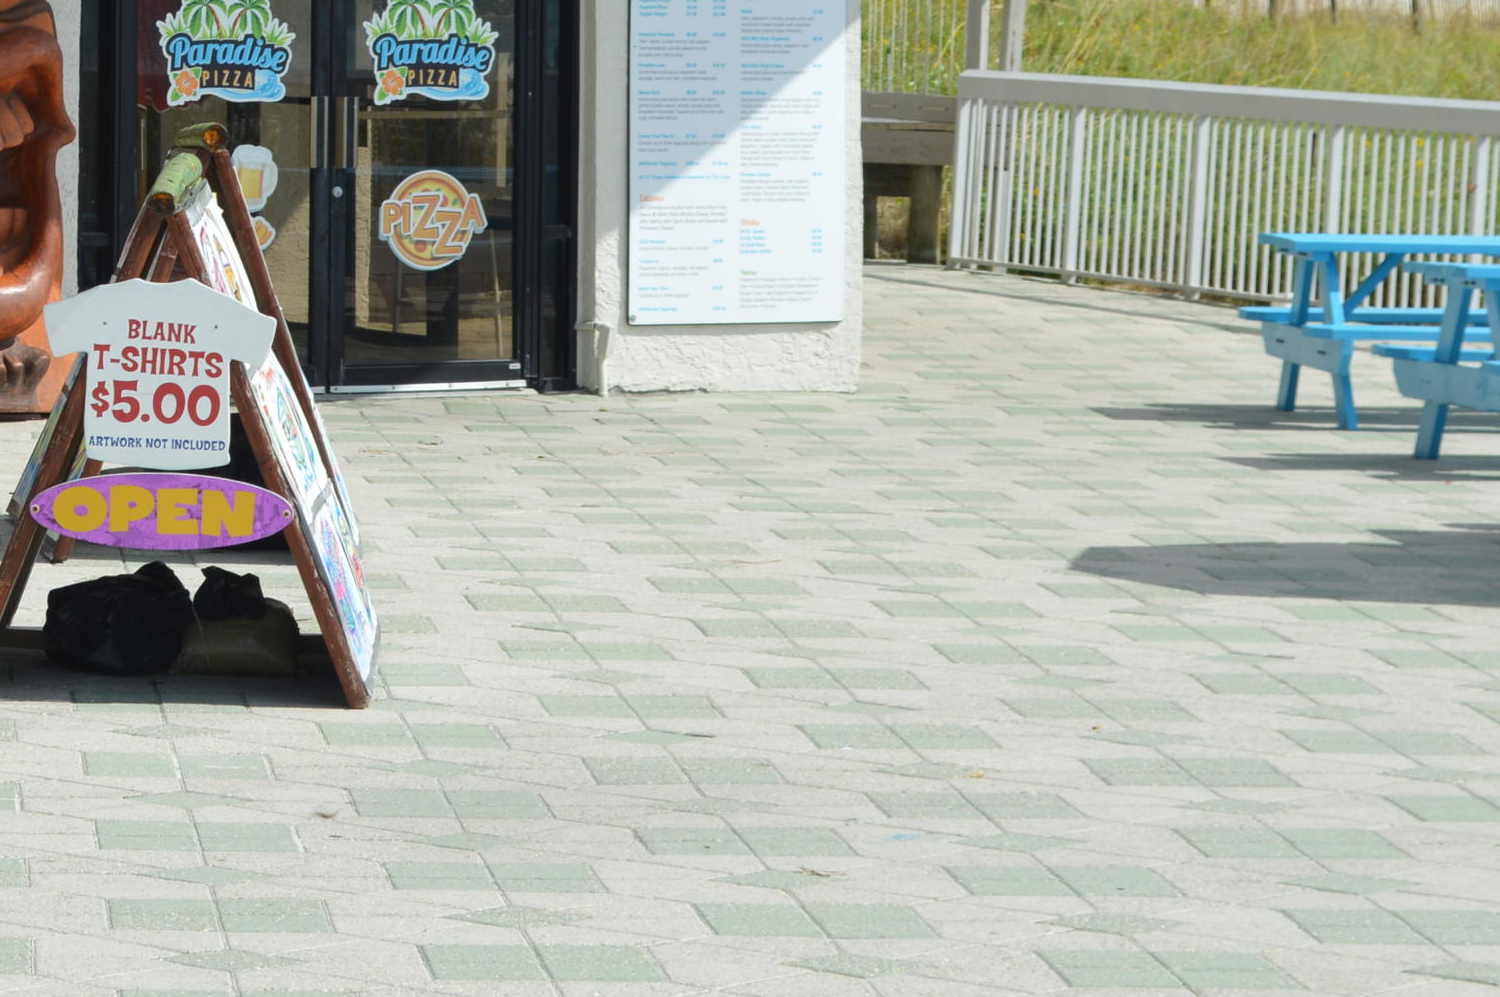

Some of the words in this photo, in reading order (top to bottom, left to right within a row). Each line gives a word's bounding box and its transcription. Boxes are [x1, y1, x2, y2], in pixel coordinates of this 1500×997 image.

[168, 36, 288, 72] Paradise
[375, 36, 492, 72] Paradise
[201, 69, 254, 88] PIZZA
[408, 69, 458, 87] PIZZA
[380, 193, 487, 258] PIZZA
[128, 318, 197, 345] BLANK
[93, 344, 223, 379] T-SHIRTS
[90, 379, 221, 426] $5.00
[88, 436, 142, 449] ARTWORK
[145, 437, 168, 450] NOT
[171, 437, 226, 452] INCLUDED
[52, 484, 257, 538] OPEN
